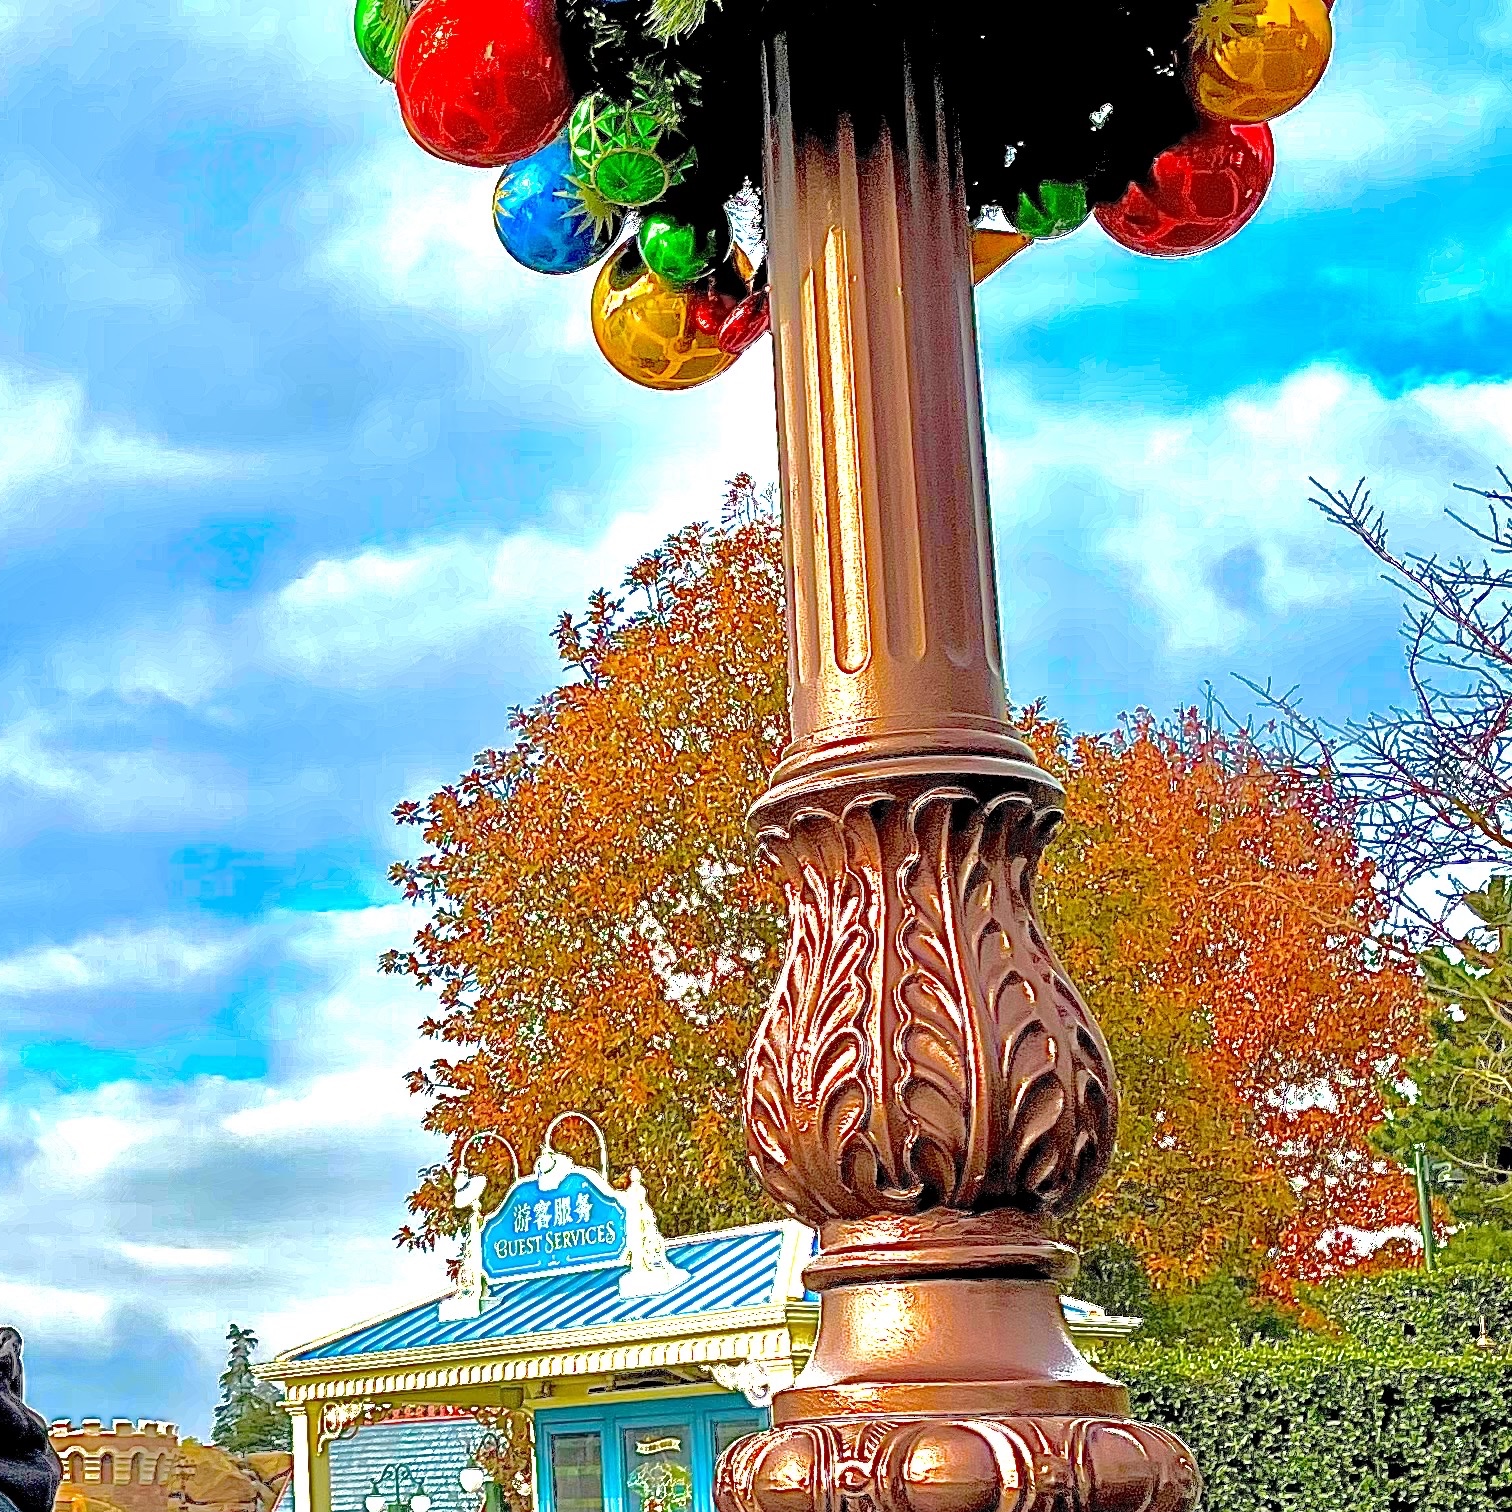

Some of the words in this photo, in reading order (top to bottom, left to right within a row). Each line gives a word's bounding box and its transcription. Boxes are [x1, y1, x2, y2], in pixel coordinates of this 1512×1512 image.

[513, 1192, 593, 1233] 游客服务
[494, 1235, 542, 1258] GUEST
[545, 1220, 616, 1253] SERVICES
